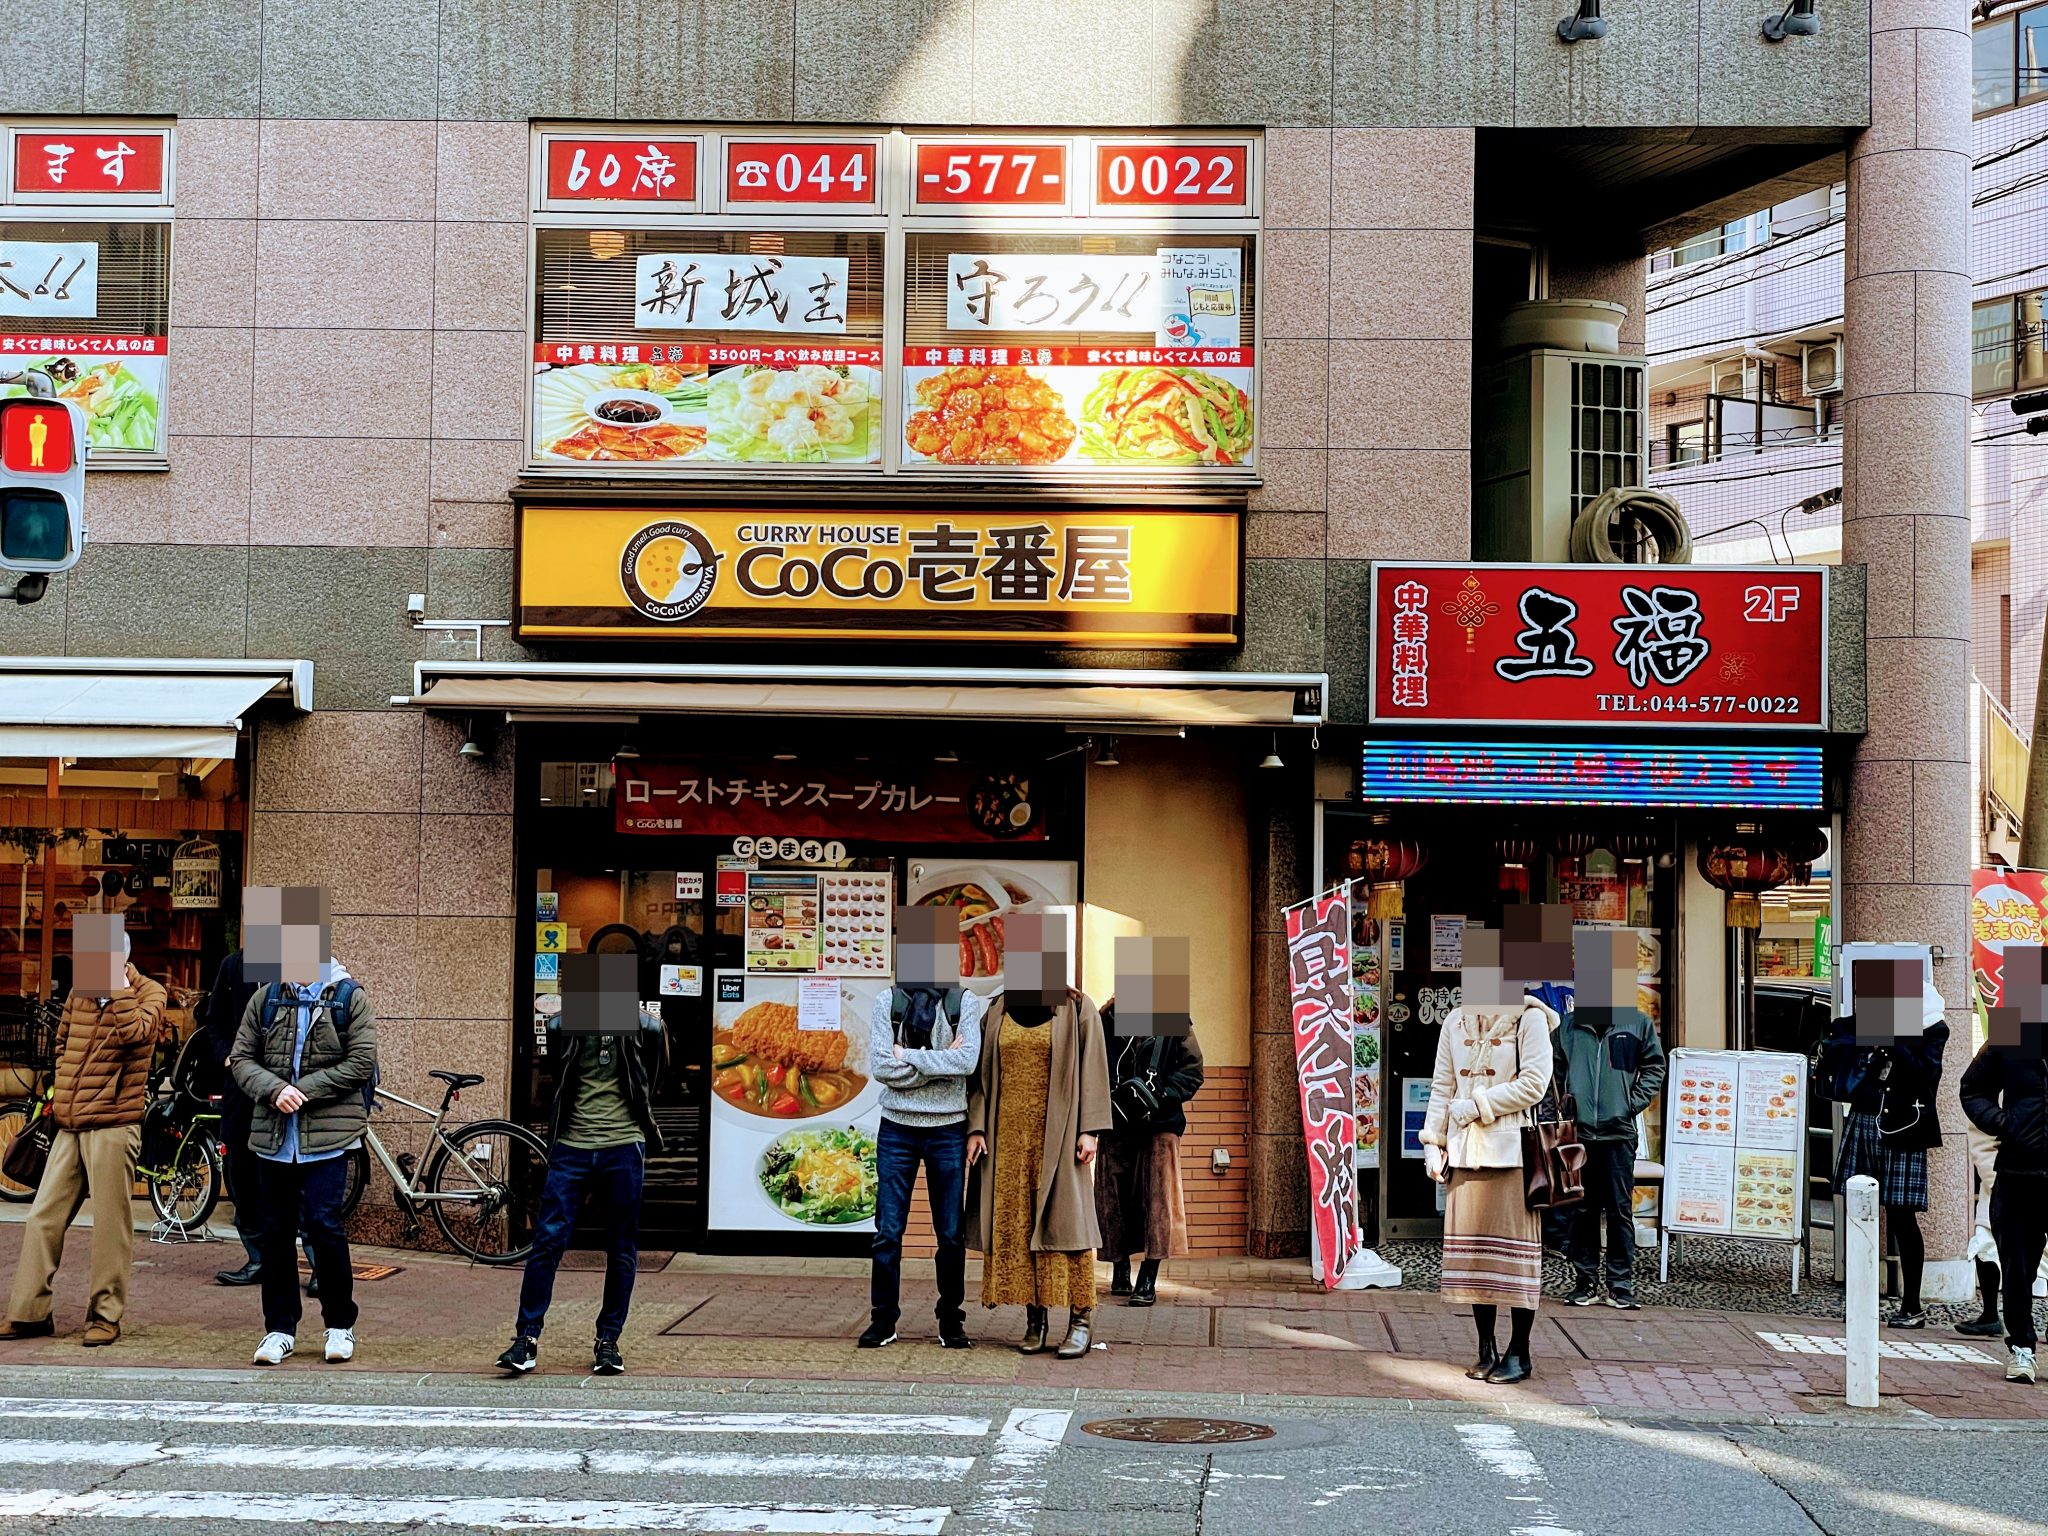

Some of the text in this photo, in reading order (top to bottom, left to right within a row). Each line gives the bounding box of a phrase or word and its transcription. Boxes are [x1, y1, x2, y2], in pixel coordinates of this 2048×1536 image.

[43, 141, 136, 186] ます
[567, 145, 676, 197] 60席
[776, 153, 867, 193] 044
[1108, 156, 1234, 195] 0022
[2, 339, 156, 351] 安くて美味しくて人気の店
[556, 345, 684, 362] 中華料理 五福
[925, 348, 1009, 365] 中華料理
[1087, 350, 1242, 363] 安くて美味しくて人気の店
[625, 551, 635, 574] Good
[649, 525, 671, 537] Good
[671, 526, 692, 538] curry
[737, 525, 899, 544] CURRY HOUSE
[1744, 586, 1800, 622] 2F
[1393, 581, 1428, 707] 中華料理
[1497, 585, 1711, 689] 五福
[1597, 694, 1799, 713] TEL:044-577-0022
[625, 777, 960, 812] ローストチキンスープカレー
[736, 840, 838, 860] できます!
